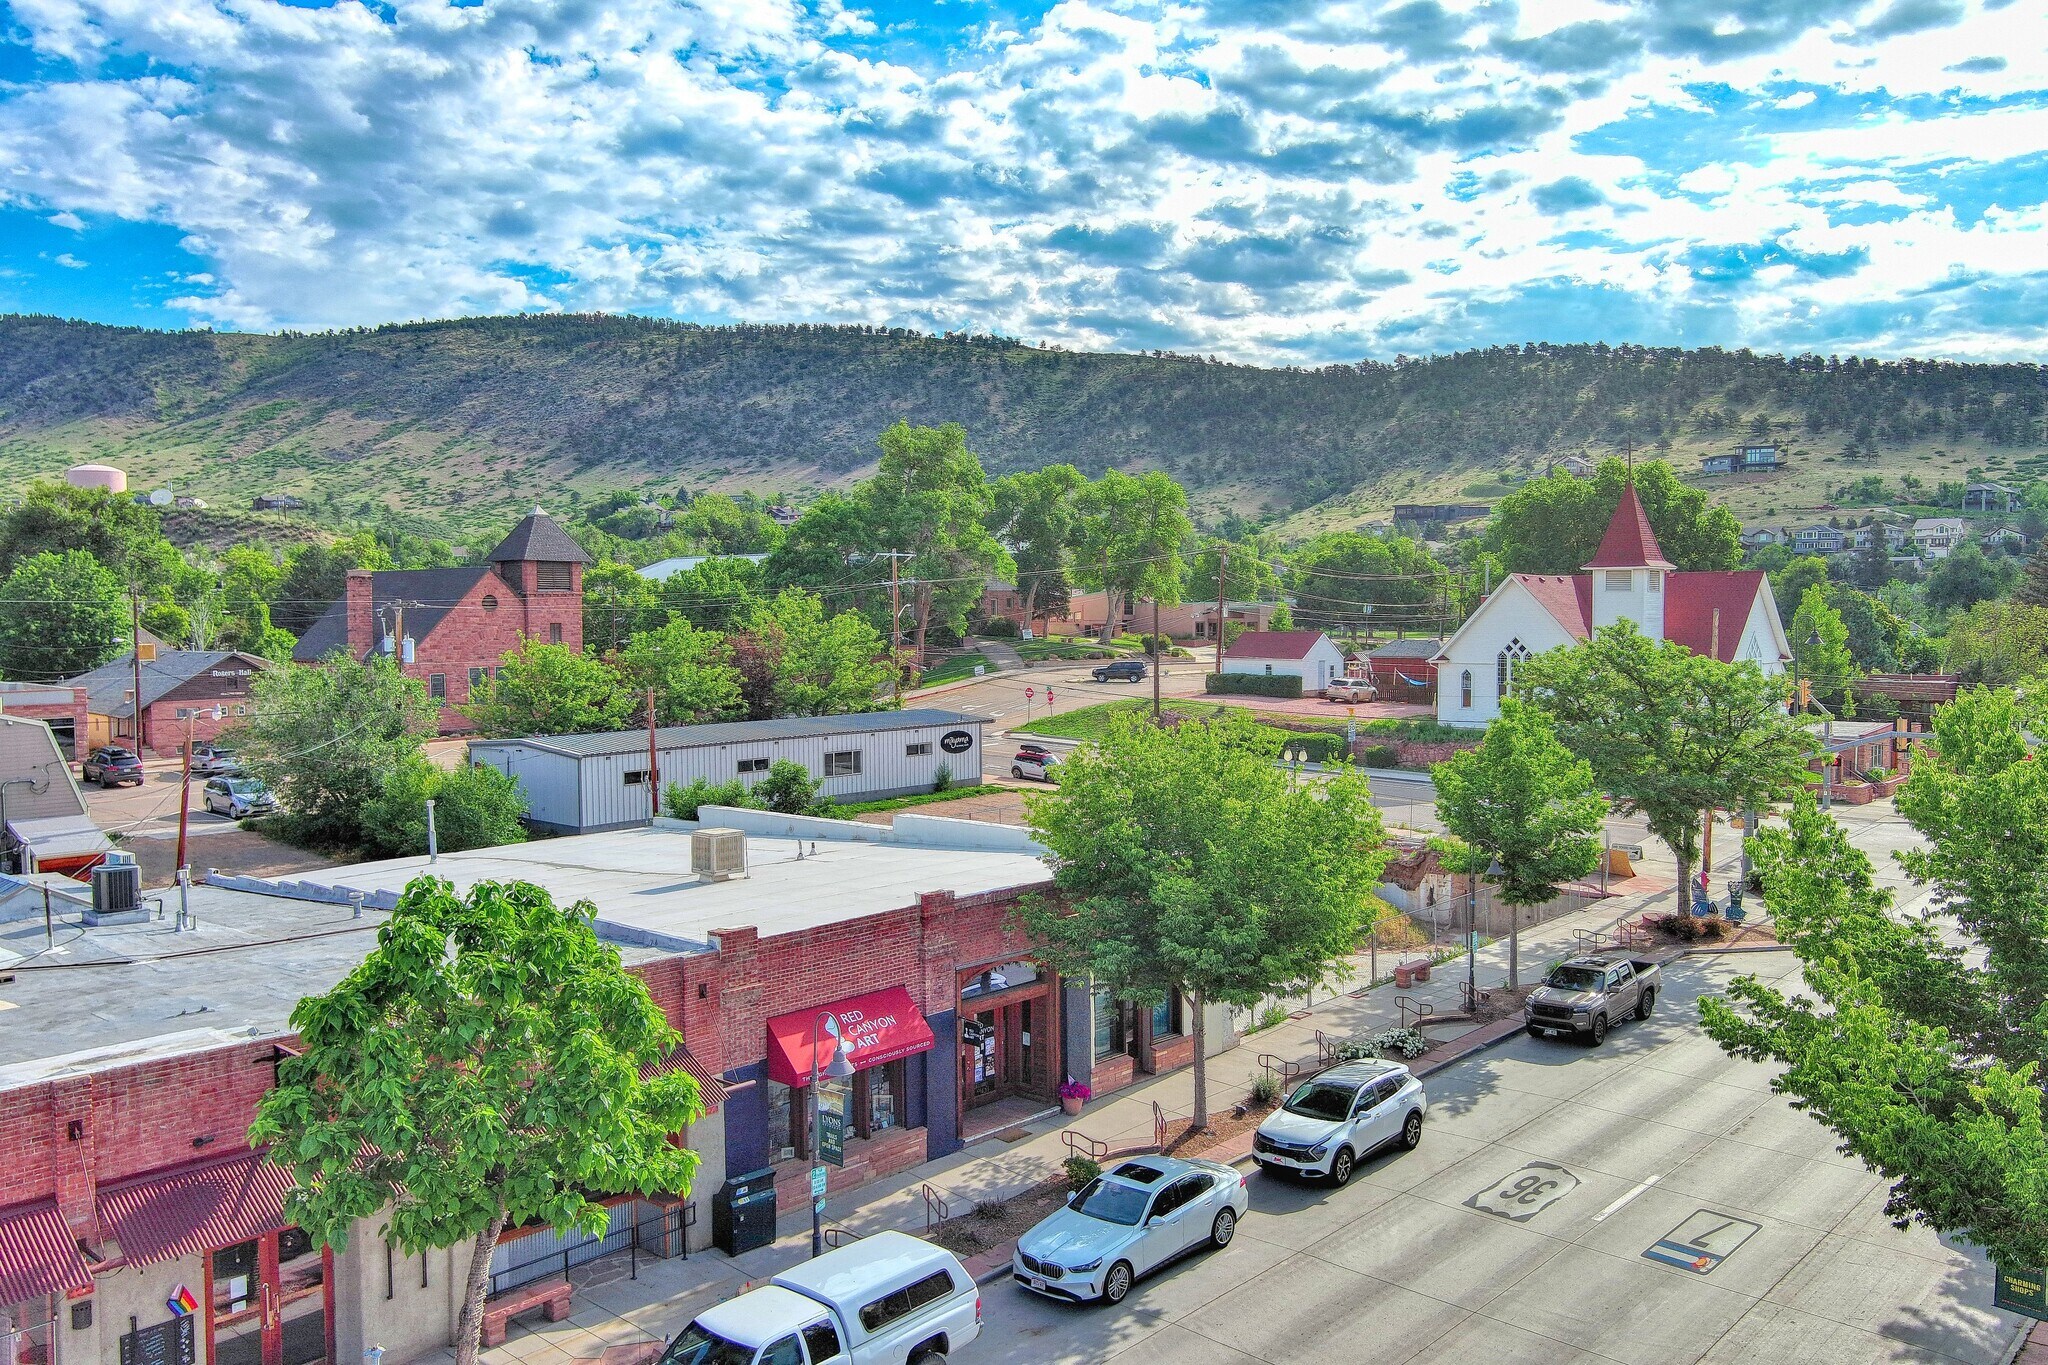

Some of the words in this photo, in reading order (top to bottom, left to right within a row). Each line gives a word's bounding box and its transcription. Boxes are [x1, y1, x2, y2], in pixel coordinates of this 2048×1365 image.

[840, 1010, 864, 1025] RED
[848, 1014, 898, 1036] CANYON
[857, 1033, 881, 1049] ART
[868, 1047, 905, 1063] CONSCIOUSLY
[905, 1040, 931, 1053] SOURCED
[822, 1115, 841, 1126] LYONS
[1500, 1175, 1558, 1205] 36
[1689, 1221, 1735, 1249] 7
[2003, 1275, 2041, 1292] CHARMING
[2010, 1284, 2034, 1297] SHOPS
